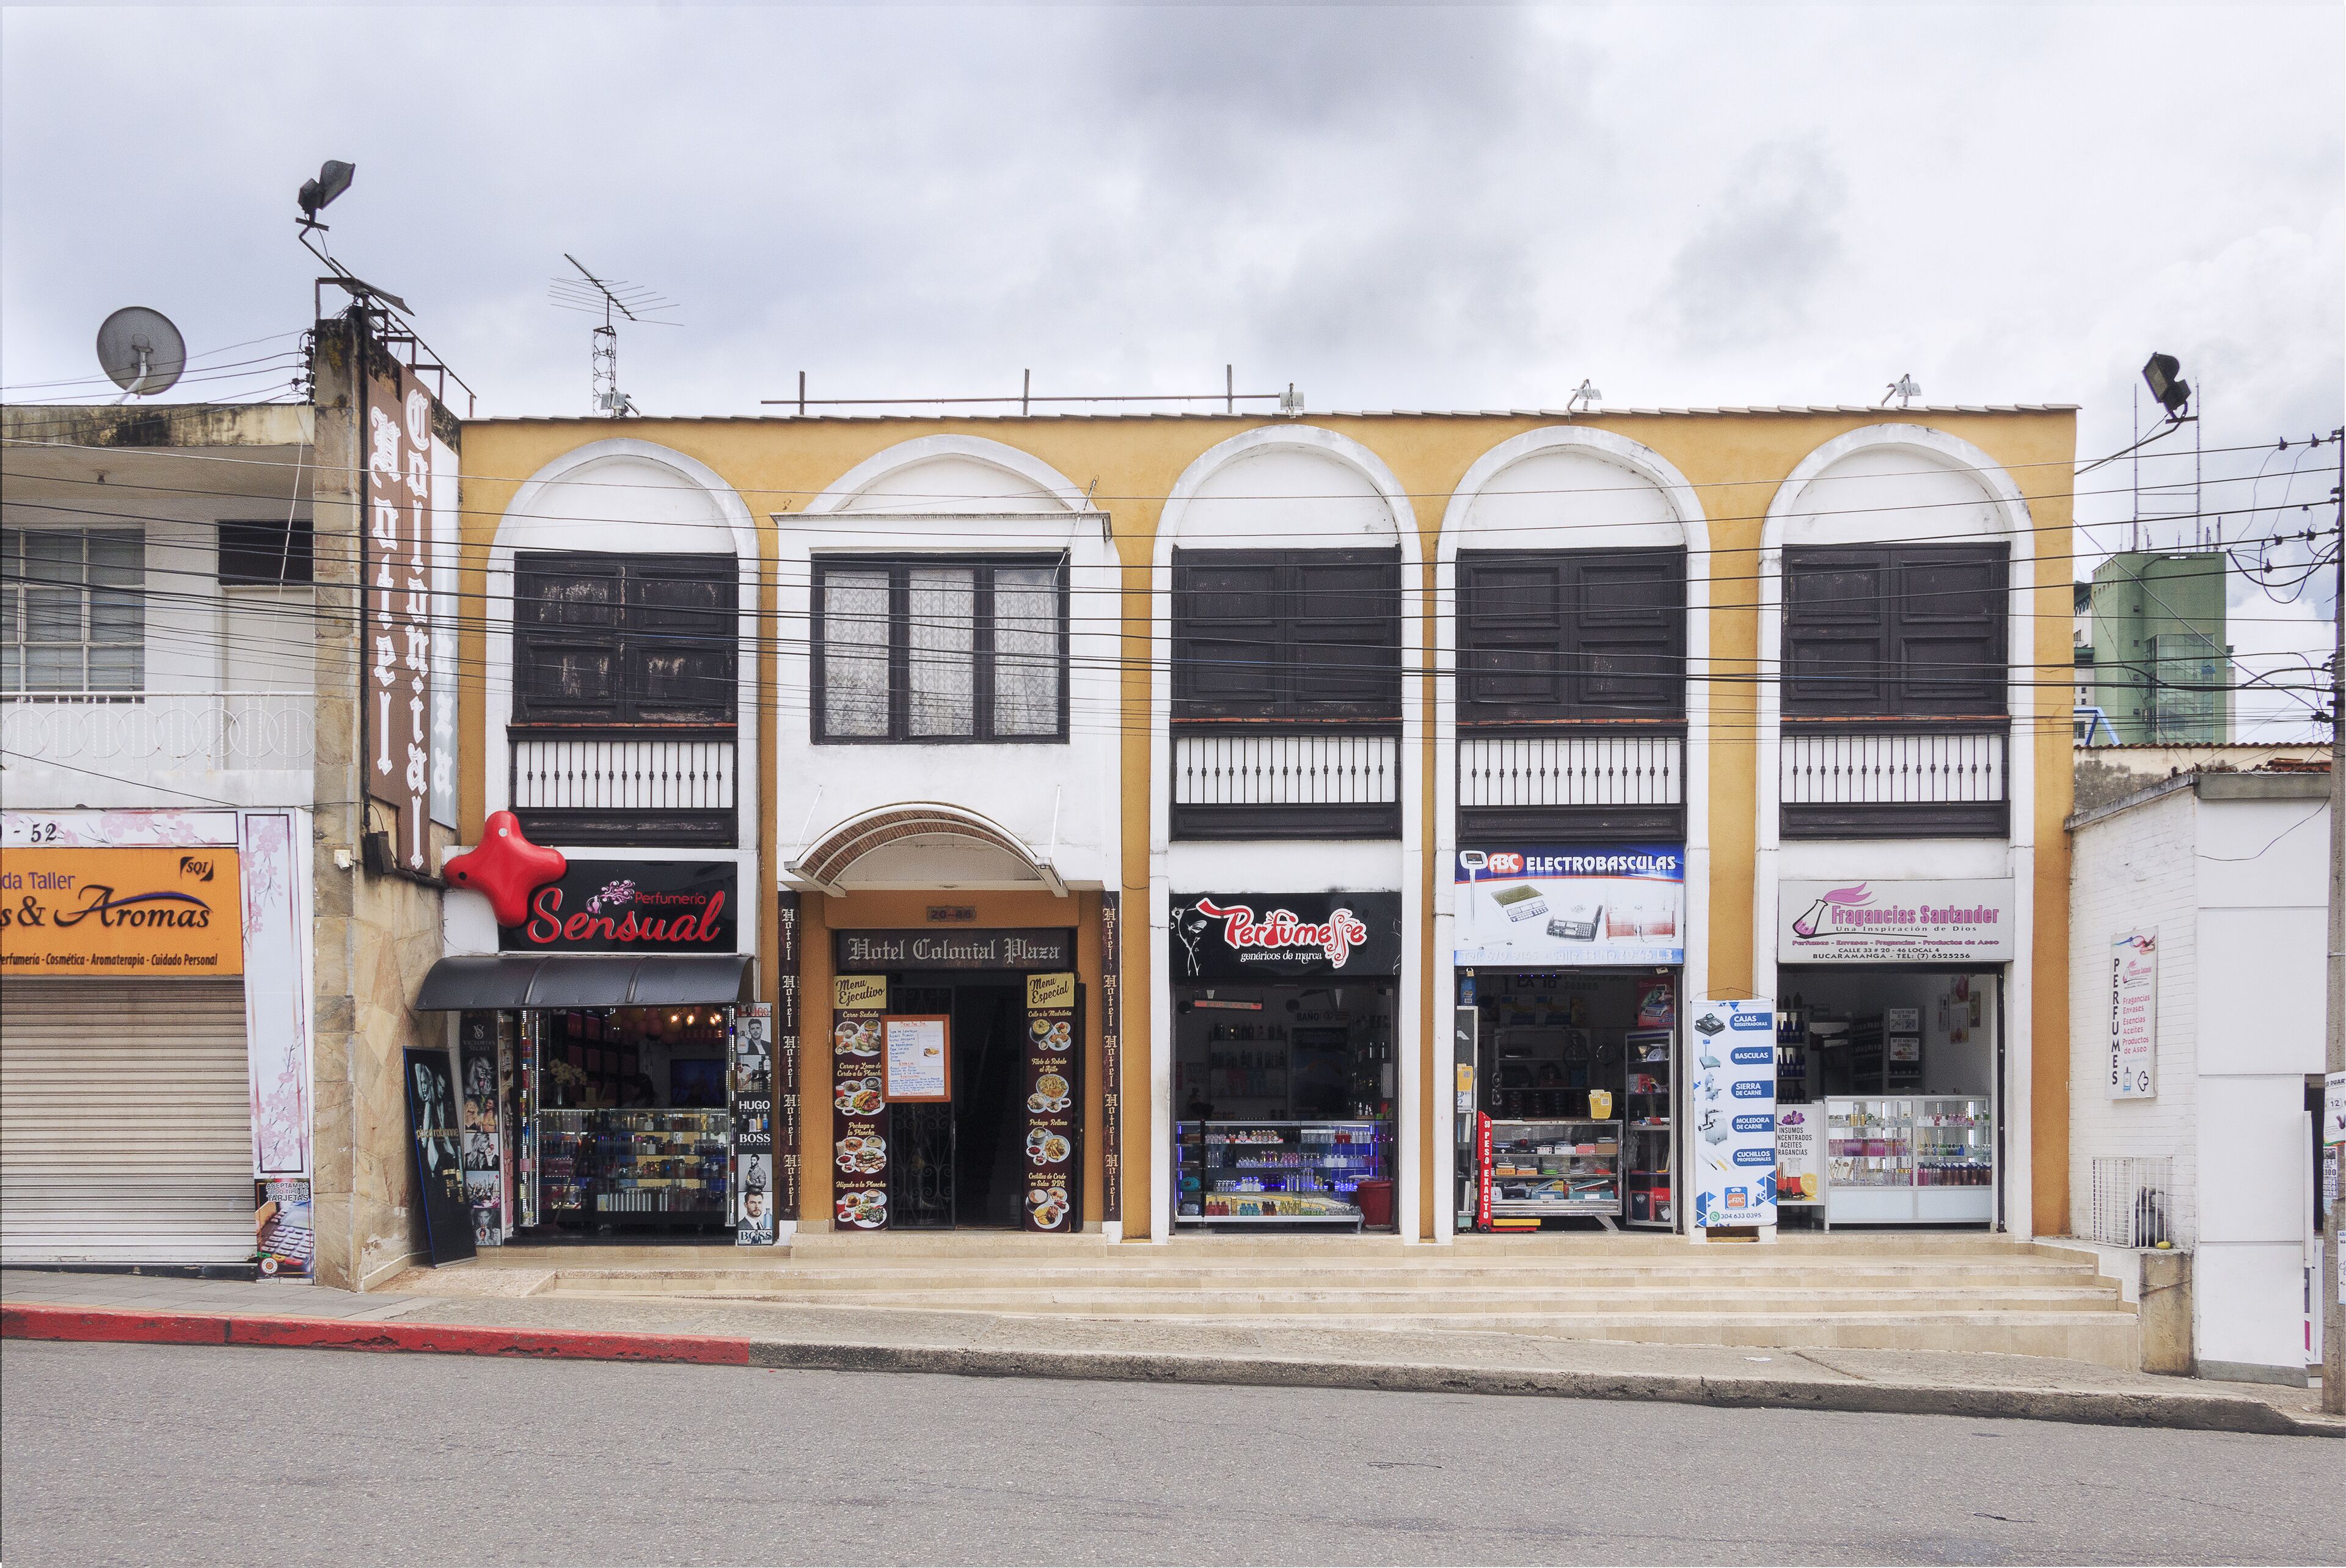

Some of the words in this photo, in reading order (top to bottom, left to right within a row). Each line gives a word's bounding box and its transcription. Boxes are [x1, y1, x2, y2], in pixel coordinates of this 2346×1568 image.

[369, 405, 402, 776] Hotel
[406, 388, 429, 870] Colonial
[31, 822, 57, 842] 52
[1489, 853, 1520, 871] ABC
[1527, 855, 1676, 872] ELECTROBASCULAS
[28, 872, 76, 889] Taller
[17, 895, 46, 927] &
[54, 884, 211, 928] Aromas
[635, 891, 706, 905] Perfumería
[527, 887, 726, 944] Sensual
[1832, 905, 1916, 927] Fragancias
[1920, 905, 1999, 924] Santander
[781, 909, 795, 960] Hotel
[1103, 908, 1116, 960] Hotel
[46, 952, 85, 965] Cosmética
[90, 954, 144, 968] Aromaterapia
[152, 954, 181, 966] Cuidado
[184, 953, 217, 966] Personal
[848, 938, 905, 961] Hotel
[913, 938, 996, 960] Colonial
[1004, 938, 1060, 964] Plaza
[1240, 951, 1281, 963] genéricos
[1282, 950, 1293, 960] de
[1295, 952, 1322, 964] marca
[836, 979, 868, 993] Menu
[1029, 977, 1056, 991] Menu
[1032, 980, 1069, 1004] Especial
[782, 975, 795, 1027] Hotel
[839, 986, 885, 1006] Ejecutivo
[1104, 975, 1117, 1026] Hotel
[2123, 995, 2150, 1005] Fragancias
[2123, 1005, 2144, 1014] Envases
[2123, 1016, 2146, 1026] Esencias
[2111, 958, 2121, 1085] PERFUMES
[2123, 1026, 2144, 1035] Aceites
[2122, 1037, 2149, 1046] Productos
[783, 1035, 796, 1087] Hotel
[1104, 1035, 1117, 1087] Hotel
[739, 1100, 770, 1110] HUGO
[784, 1095, 797, 1145] Hotel
[1105, 1094, 1118, 1145] Hotel
[739, 1133, 771, 1143] BOSS
[784, 1154, 797, 1206] Hotel
[1105, 1154, 1119, 1208] Hotel
